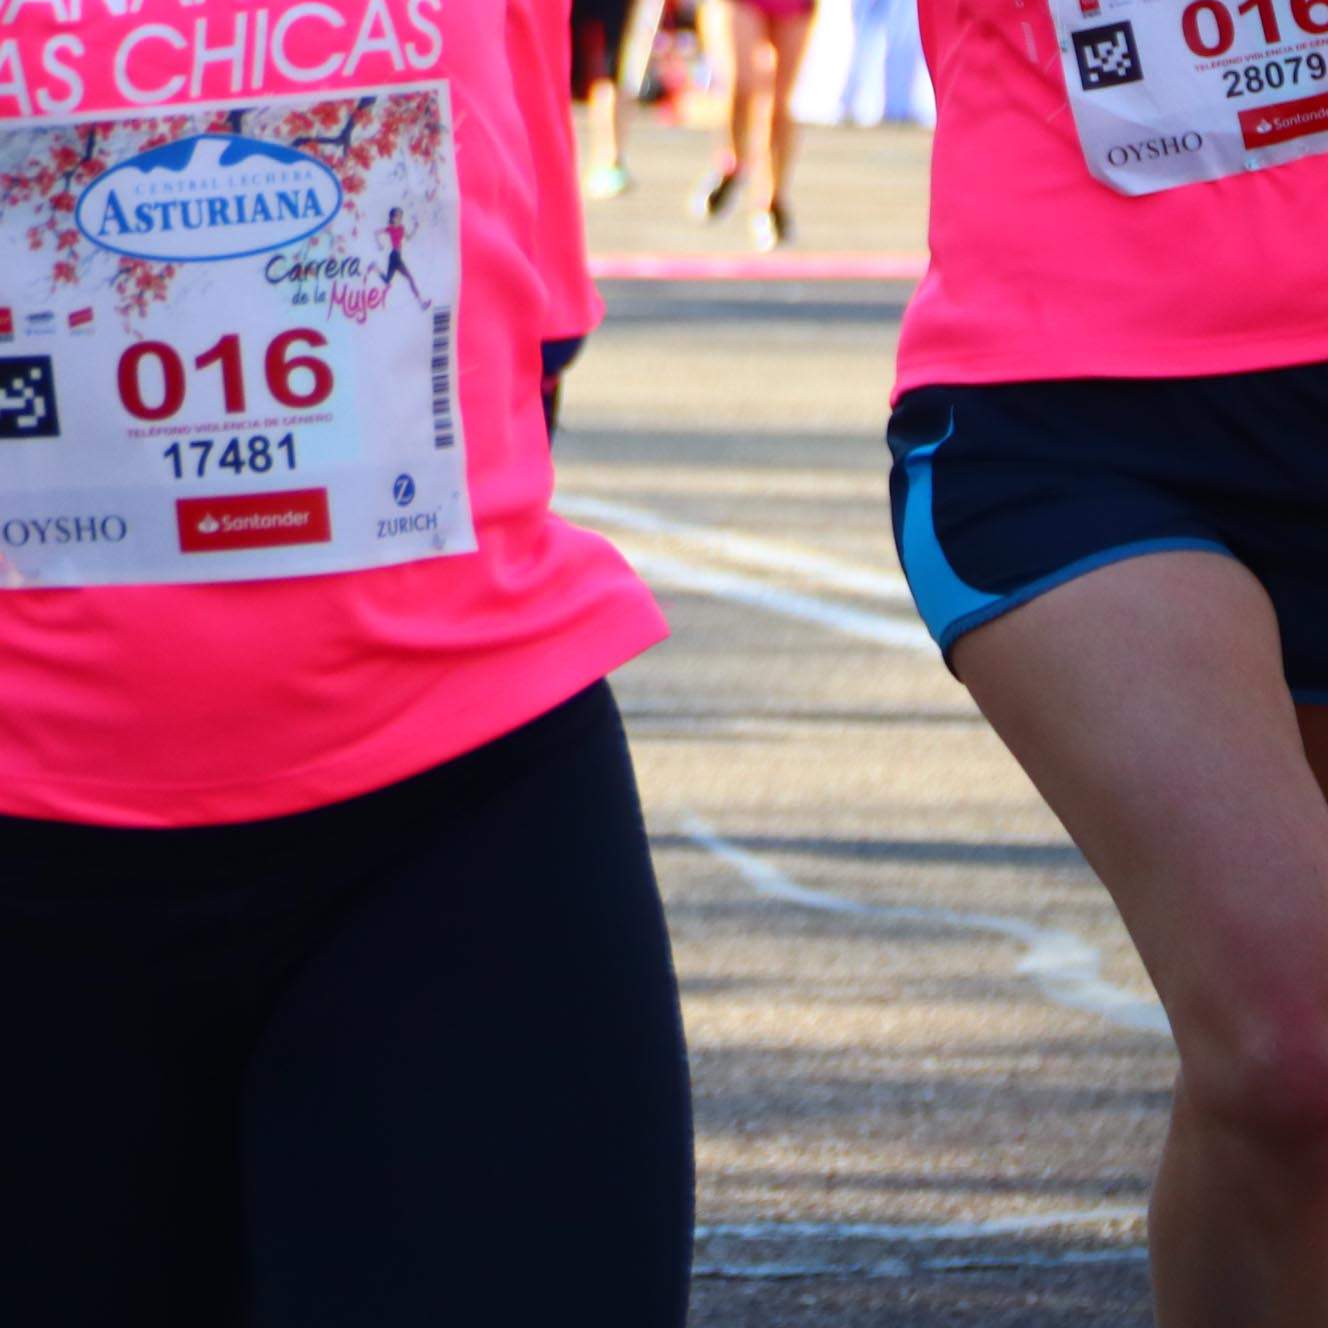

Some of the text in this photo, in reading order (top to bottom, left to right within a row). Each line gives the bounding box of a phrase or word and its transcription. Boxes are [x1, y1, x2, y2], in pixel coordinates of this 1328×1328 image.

[1223, 52, 1327, 98] 28079
[1107, 131, 1203, 167] OYSHO
[97, 186, 326, 237] ASTURIANA
[264, 254, 362, 285] Carrera
[292, 276, 390, 325] de la Mujer
[117, 328, 334, 421] 016
[163, 432, 297, 479] 17481
[2, 514, 128, 548] OYSHO
[221, 511, 310, 532] Santander
[377, 513, 438, 538] ZURICH
